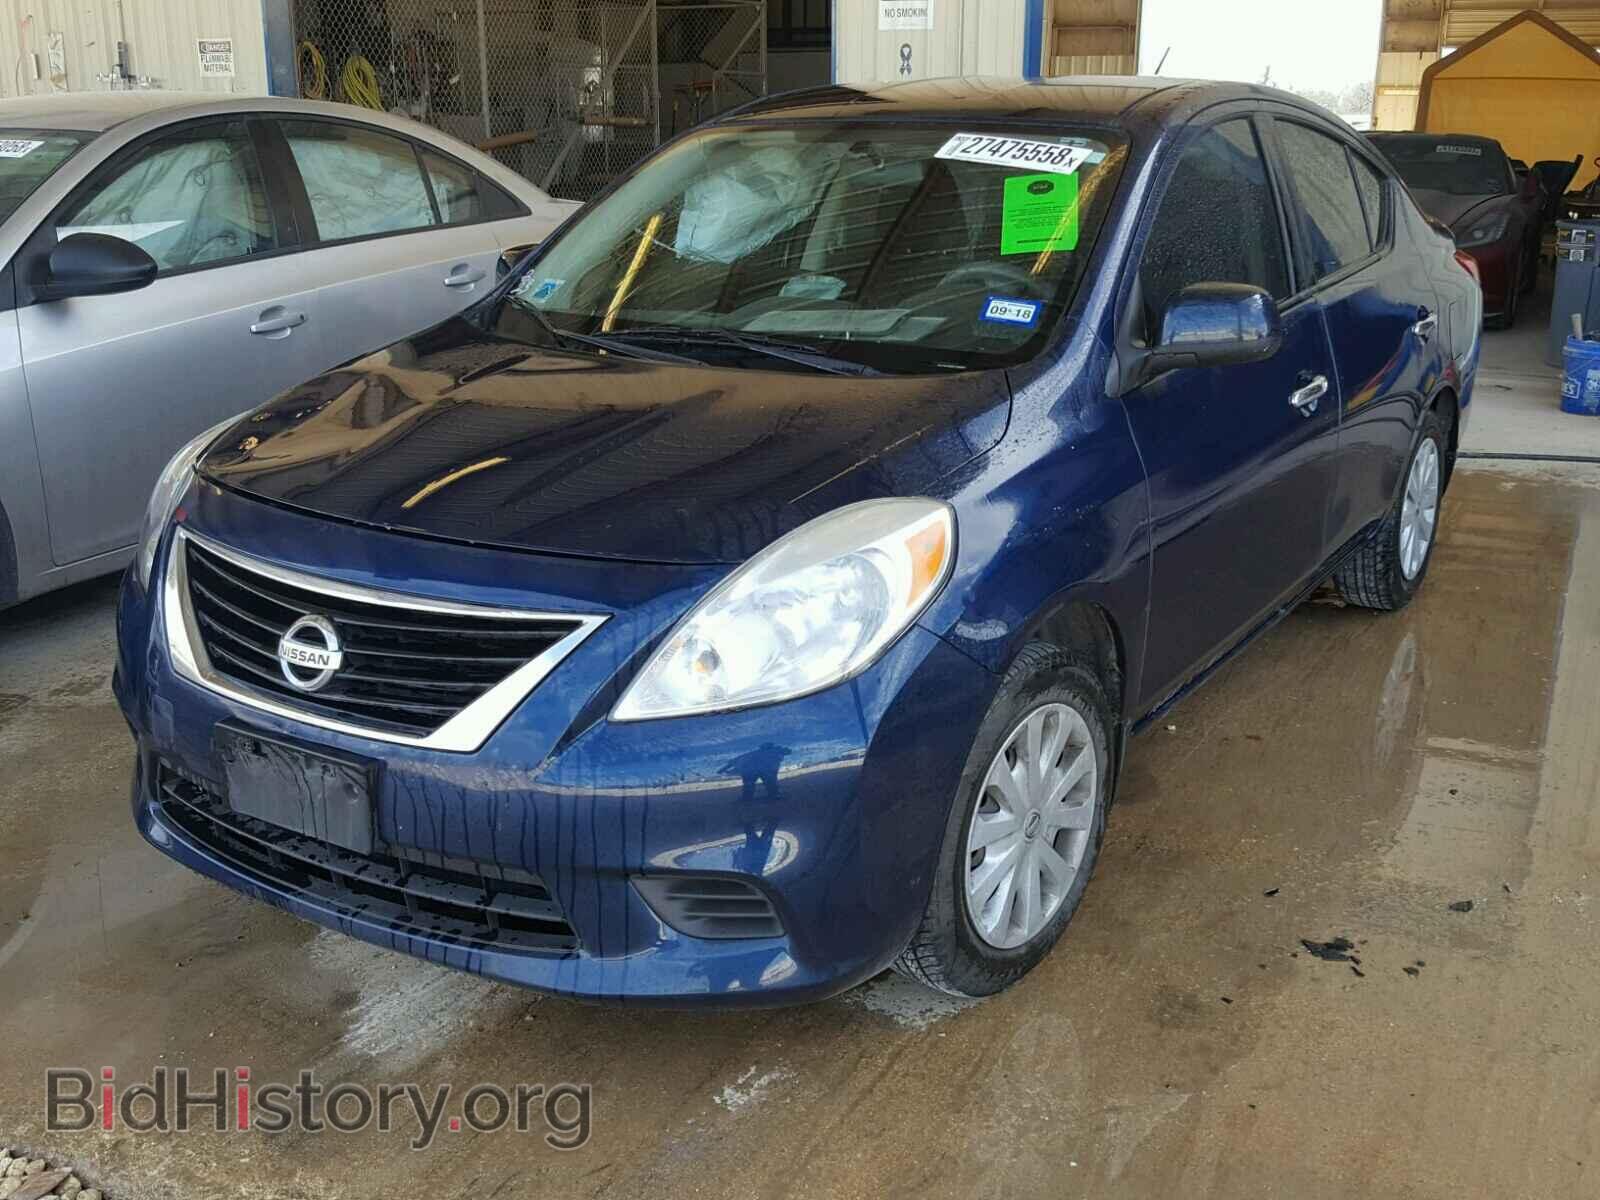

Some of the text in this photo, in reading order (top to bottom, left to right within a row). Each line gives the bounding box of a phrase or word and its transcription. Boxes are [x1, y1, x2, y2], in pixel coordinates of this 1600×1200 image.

[884, 7, 928, 17] NO SMOKIN
[960, 136, 1073, 165] 27475558
[281, 644, 330, 666] NISSAN
